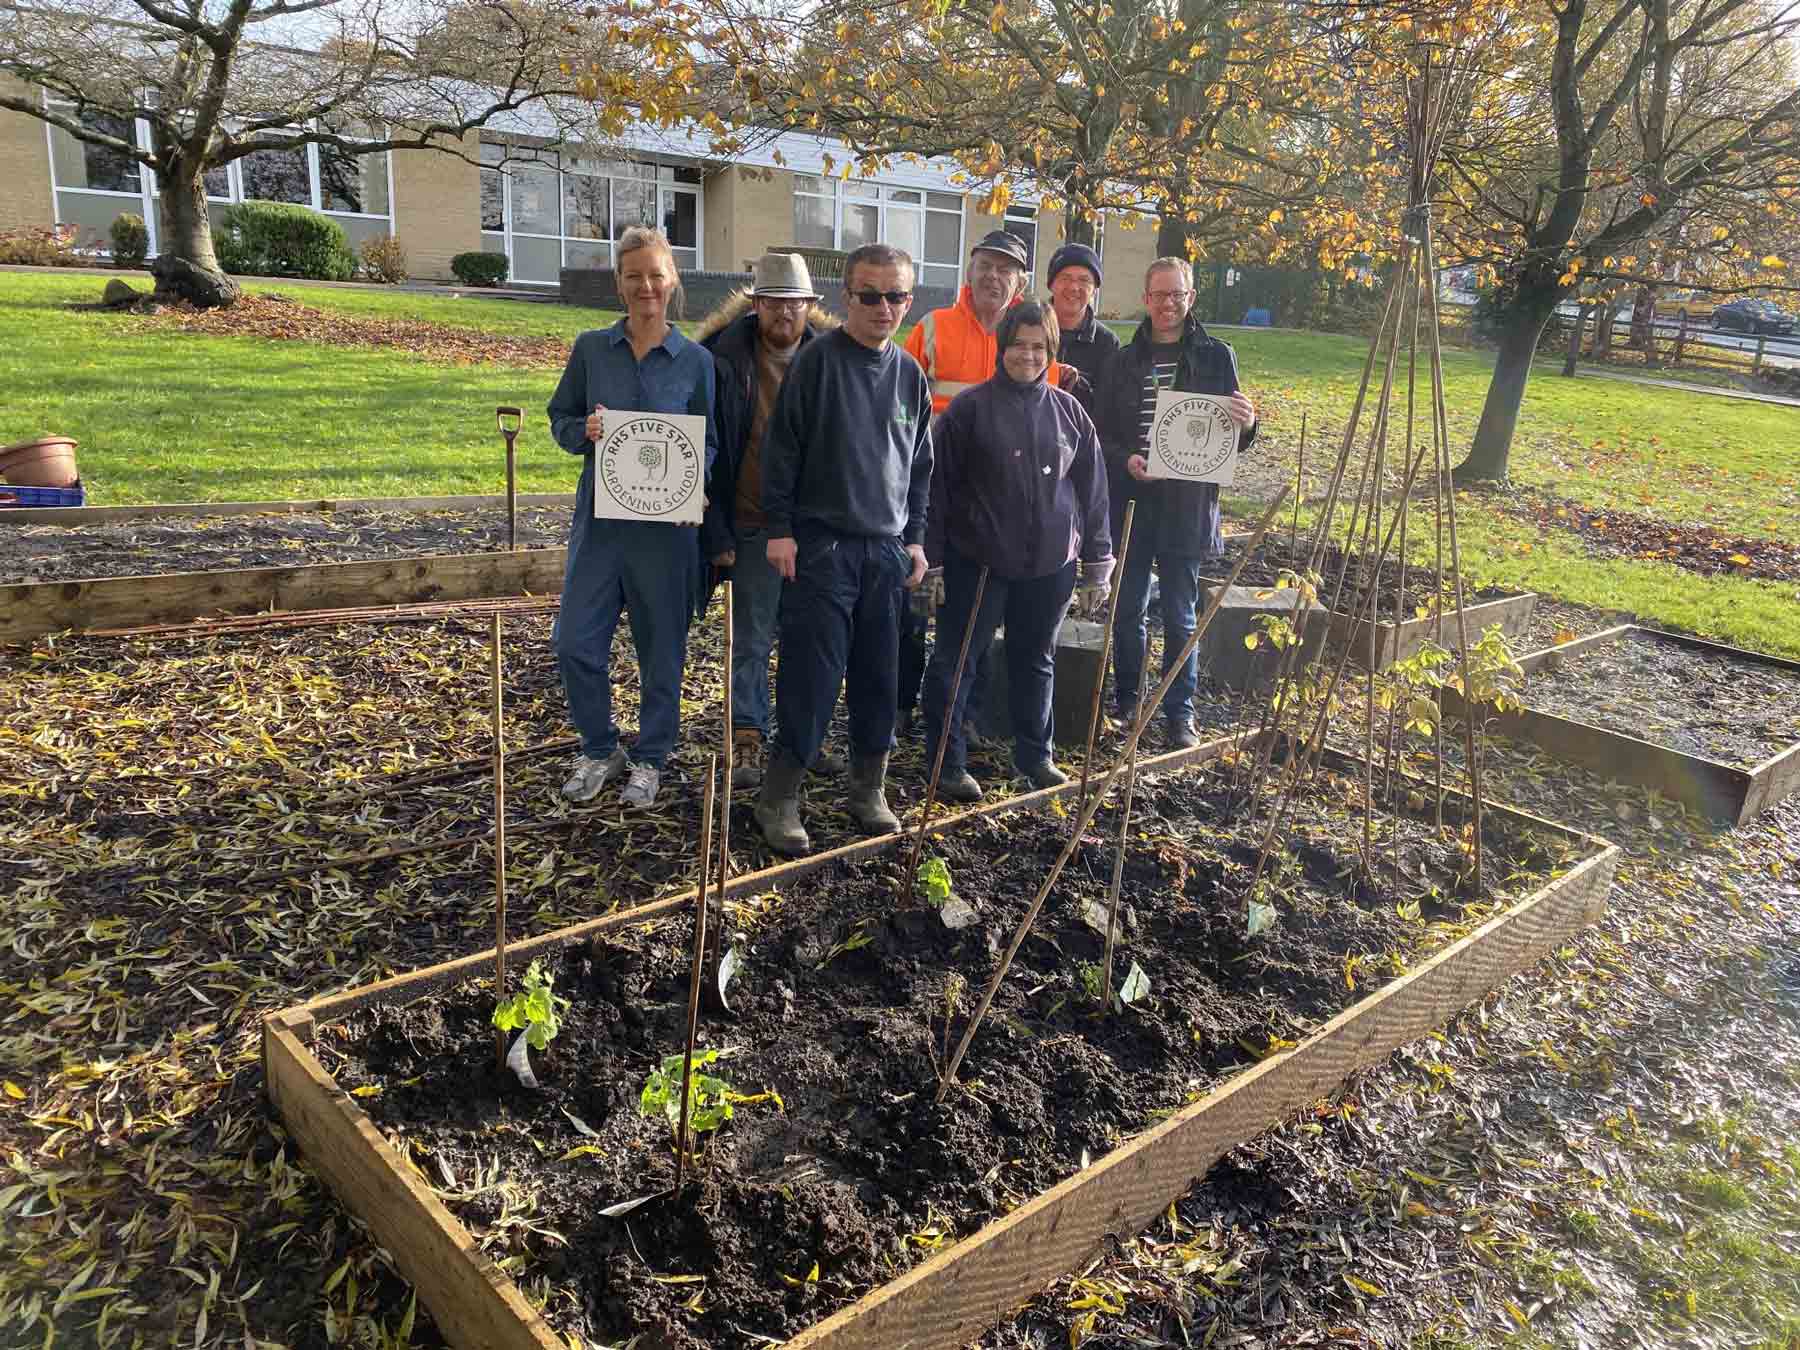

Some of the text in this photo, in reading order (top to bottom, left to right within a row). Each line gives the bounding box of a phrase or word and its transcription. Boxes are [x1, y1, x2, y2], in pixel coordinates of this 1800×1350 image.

[1163, 401, 1231, 432] RHS FIVE STAR
[607, 422, 693, 460] RHS FIVE STAR
[1159, 429, 1232, 473] GARDENING SCHOOL
[605, 458, 696, 512] GARDENING SCHOOL
